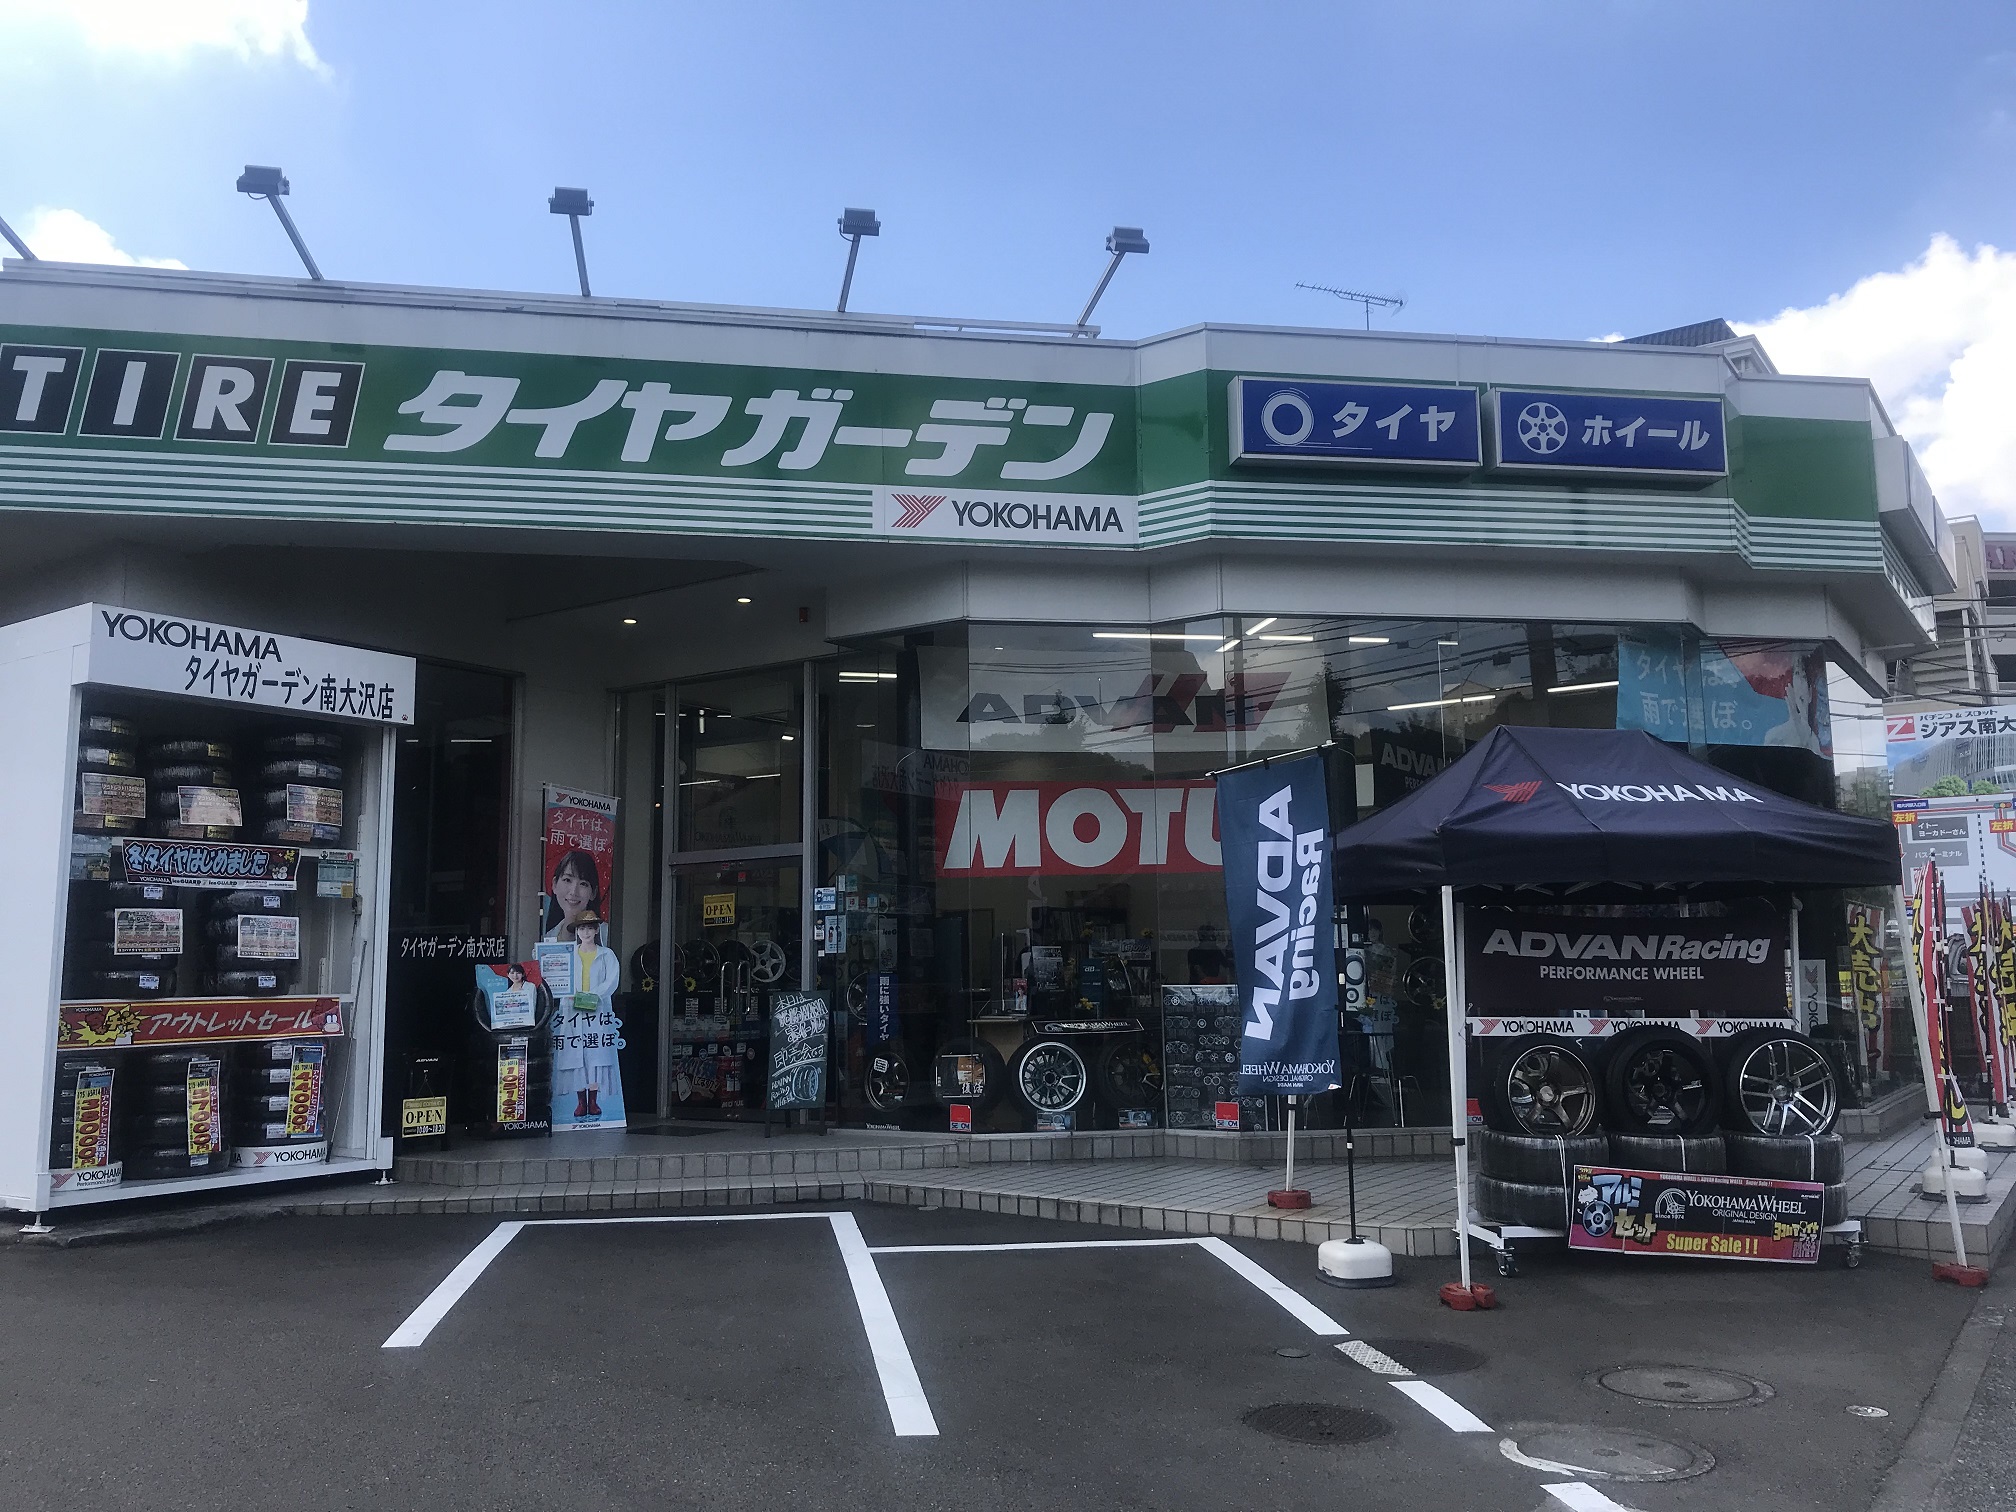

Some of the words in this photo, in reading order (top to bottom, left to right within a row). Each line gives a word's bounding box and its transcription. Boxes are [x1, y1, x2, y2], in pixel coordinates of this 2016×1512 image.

[12, 356, 343, 434] TIRE
[383, 370, 1115, 481] タイヤガーデン
[1332, 401, 1456, 442] タイヤ
[1582, 415, 1711, 451] ホイール
[951, 500, 1124, 533] YOKOHAMA
[102, 610, 282, 662] YOKOHAMA
[185, 655, 395, 720] タイヤガーデン南大沢店
[1920, 713, 1953, 721] パチンコ
[1965, 709, 1998, 717] スロット
[1920, 715, 2016, 739] ジアス南大
[569, 795, 611, 812] YOKOHAMA
[1557, 782, 1764, 804] YOKOHAMA
[553, 810, 609, 833] タイヤは、
[943, 787, 1223, 870] MOTU
[1893, 813, 1916, 823] 左折
[1918, 822, 1938, 830] イトー
[1991, 820, 2014, 831] 左折
[550, 828, 612, 853] 雨で選ぼ。
[1919, 829, 1967, 837] ヨーカドーさん
[126, 842, 269, 877] 冬タイヤはじめました
[1915, 850, 1963, 859] バスーミナル
[400, 936, 506, 959] タイヤガーデン南大沢店
[1482, 928, 1659, 961] ADVAN
[1658, 933, 1771, 964] Racing
[1540, 965, 1648, 980] PERFORMANCE
[1653, 966, 1704, 981] WHEEL
[879, 976, 890, 1041] 雨に強いタイヤ
[1807, 985, 1819, 1028] YOKO
[149, 1009, 314, 1036] アウトレットセール
[552, 1012, 620, 1028] タイヤは、
[1502, 1020, 1574, 1034] YOKOHAMA
[552, 1033, 624, 1051] 雨で選ぼ。
[503, 1120, 549, 1131] YOKOHAMA
[274, 1148, 326, 1162] YOKOHAMA
[77, 1167, 122, 1182] YOKOHAM
[1592, 1173, 1643, 1208] アルミ
[1614, 1208, 1659, 1244] セット
[1712, 1209, 1748, 1219] ORIGINAL
[1750, 1212, 1778, 1221] DESIGN
[1667, 1235, 1707, 1253] Super
[1713, 1238, 1742, 1254] Sale
